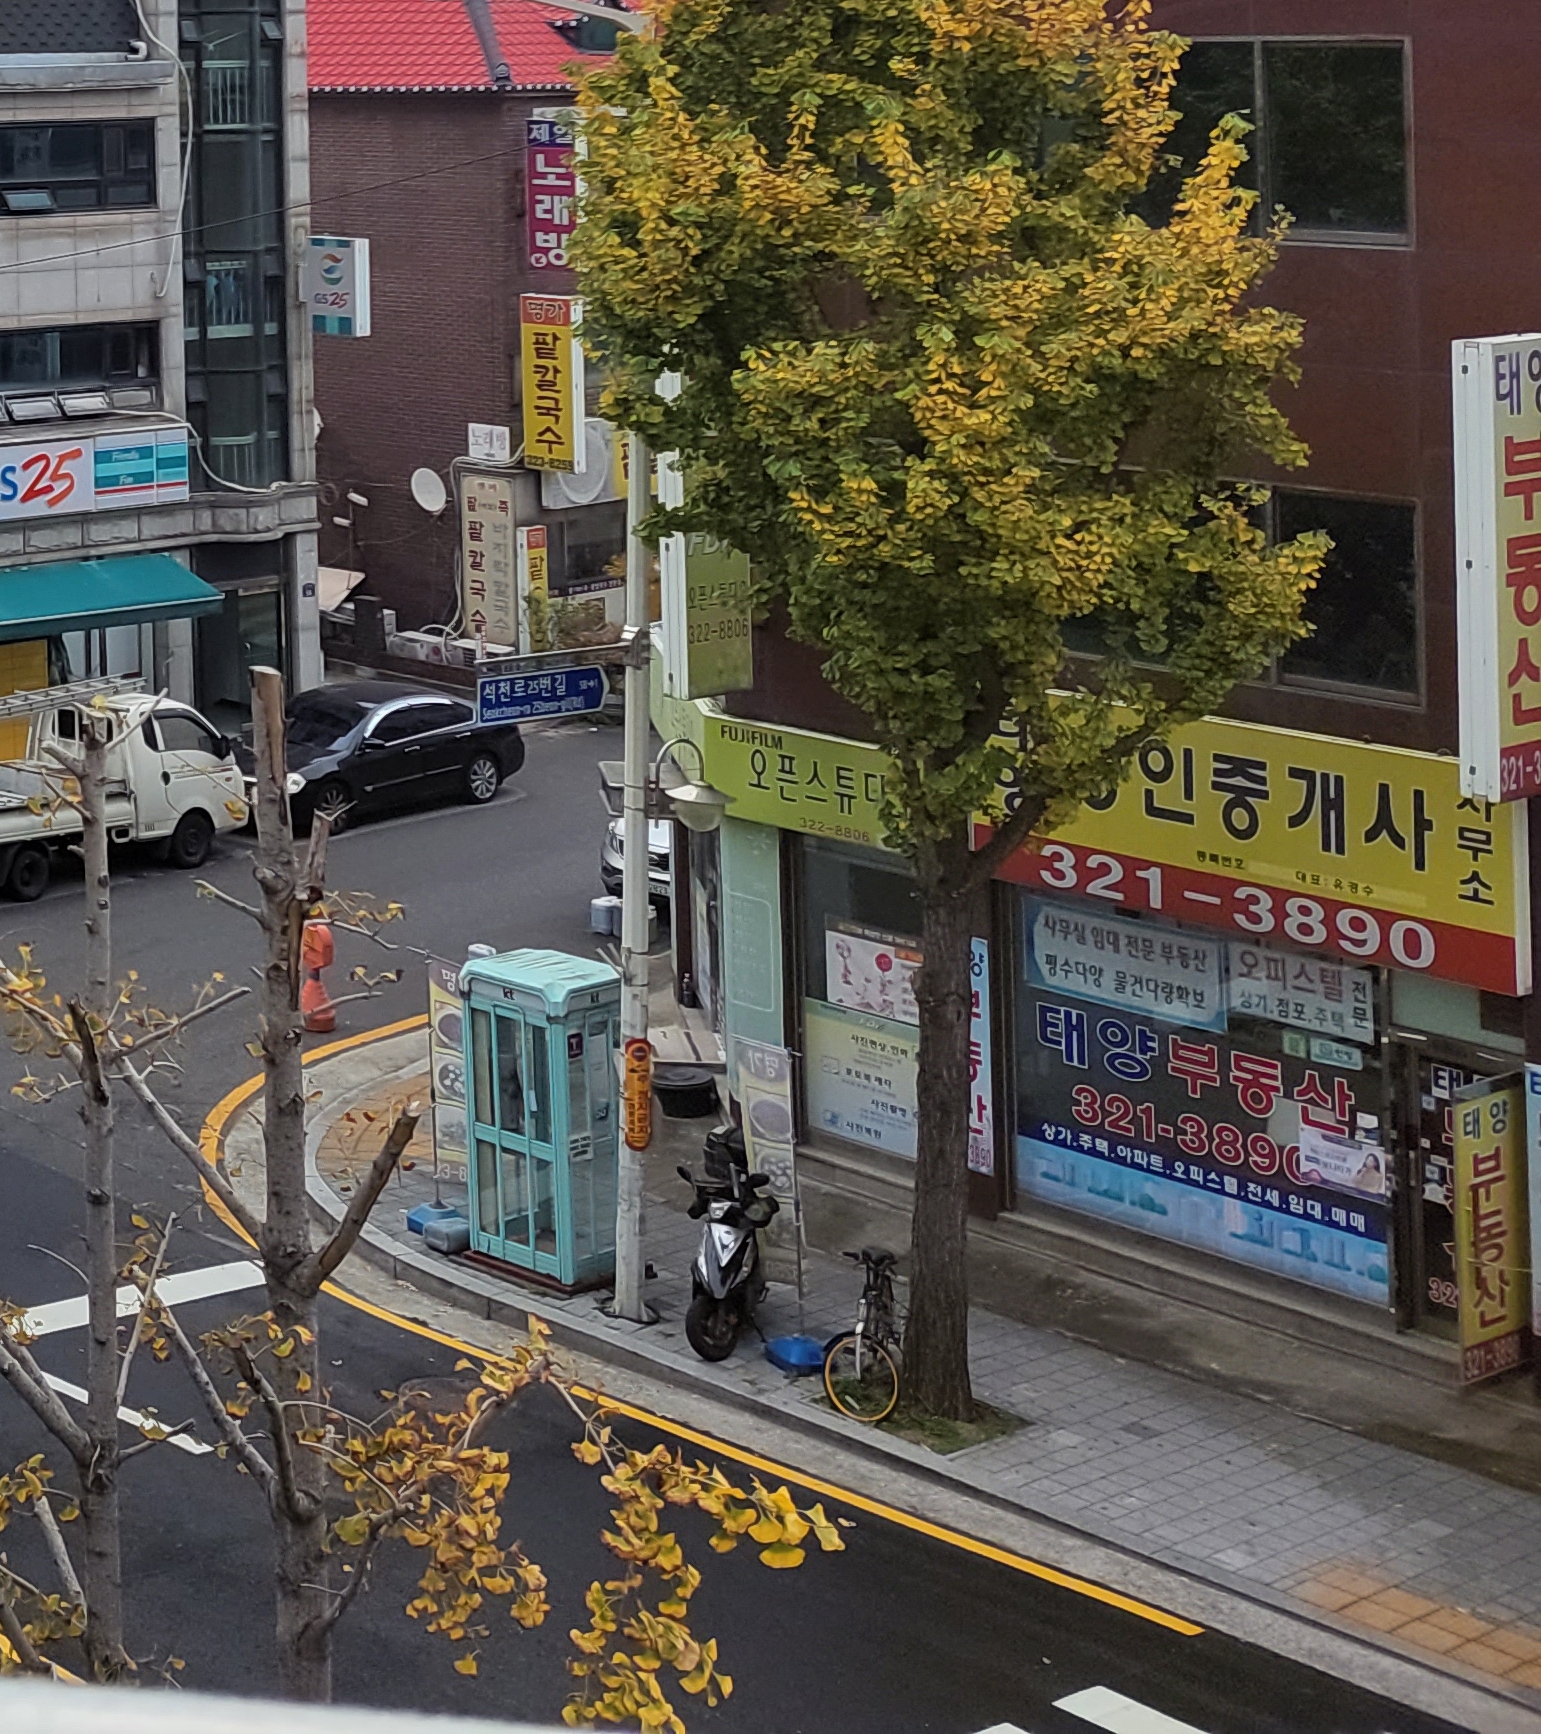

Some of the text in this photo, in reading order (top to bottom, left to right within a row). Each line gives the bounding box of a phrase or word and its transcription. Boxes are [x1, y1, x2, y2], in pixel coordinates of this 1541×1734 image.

[531, 153, 572, 266] 노래방
[314, 291, 351, 309] GS25
[527, 300, 564, 322] 명가
[532, 331, 565, 455] 팥칼국수
[688, 618, 748, 645] 322-8806
[483, 674, 567, 705] 석천로25번길
[720, 724, 783, 751] FUJIFILM
[748, 749, 886, 815] 오픈스튜디
[1083, 736, 1435, 873] 인중개사
[798, 817, 870, 842] 322-8806
[1039, 844, 1436, 969] 321-3890
[1043, 914, 1207, 973] 사무실 임대 전문 부동산
[1044, 952, 1104, 989] 평수다양
[1238, 950, 1343, 1004] 오피스텔
[1462, 1099, 1509, 1141] 태양
